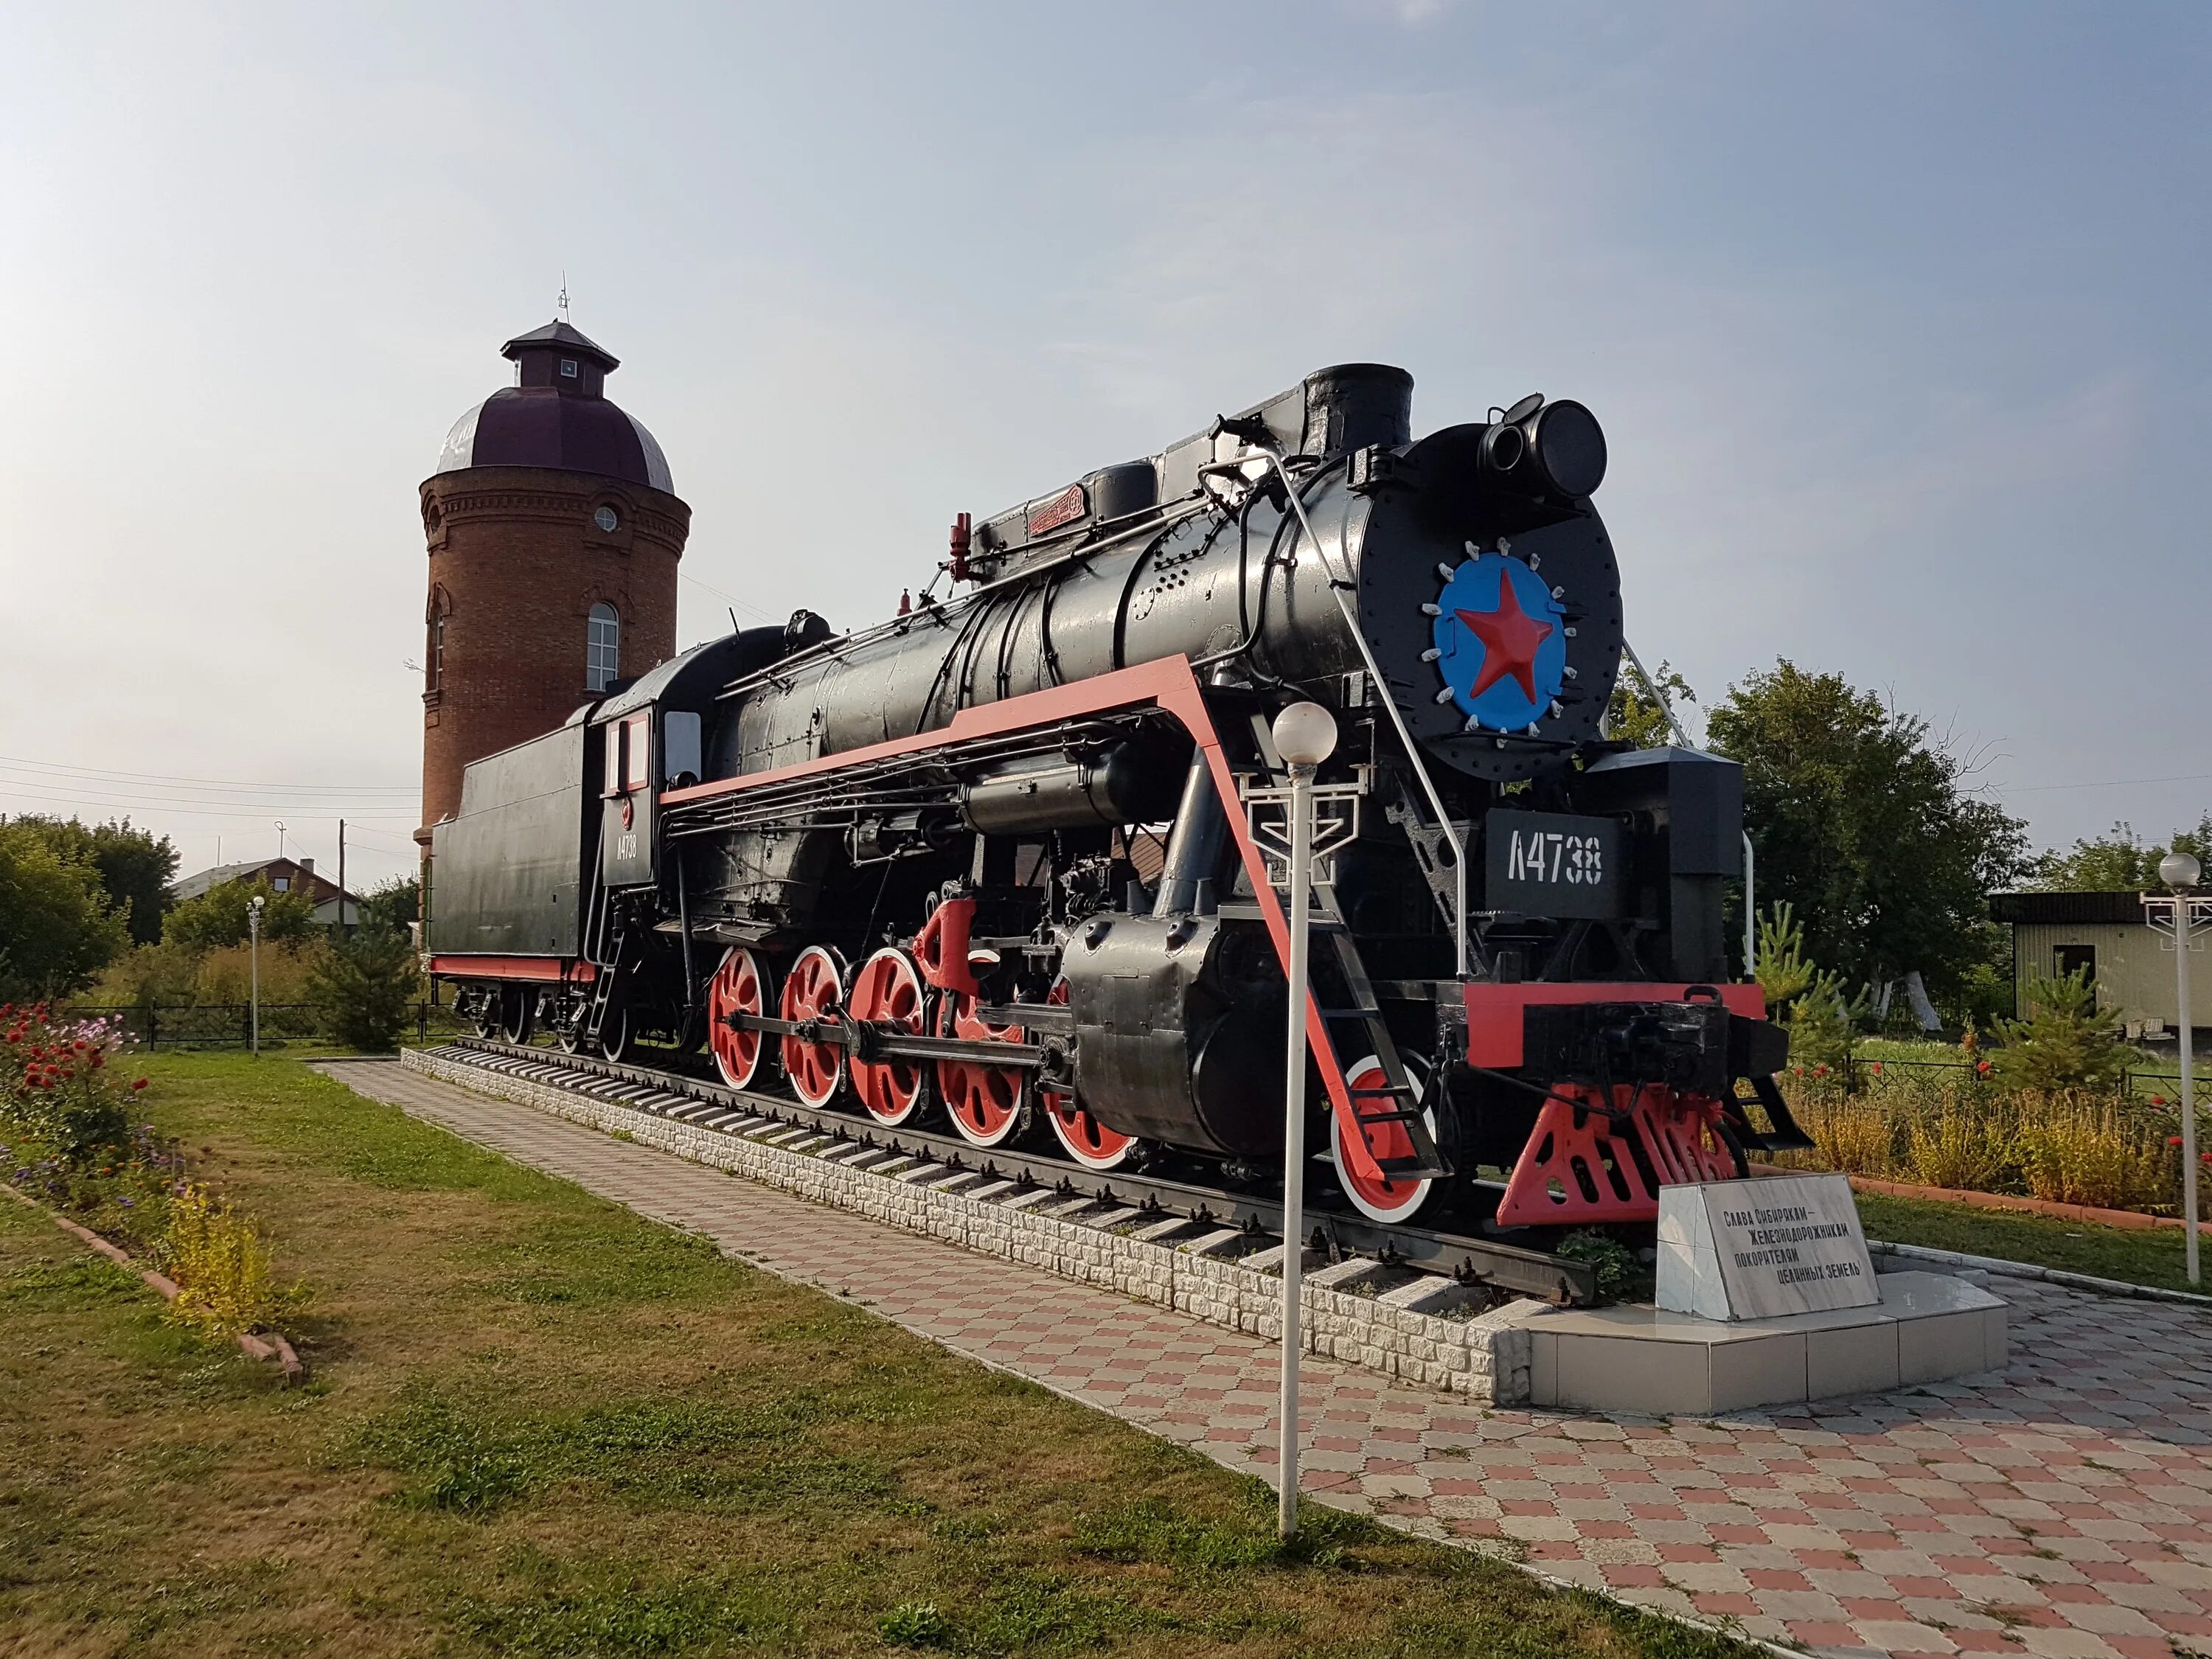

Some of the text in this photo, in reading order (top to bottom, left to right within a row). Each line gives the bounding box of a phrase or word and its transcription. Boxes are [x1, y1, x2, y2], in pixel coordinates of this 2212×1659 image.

[1724, 1211, 1754, 1227] СЛАВА
[1734, 1248, 1800, 1268] ПОКОРИТЕЛЯМ
[1777, 1265, 1825, 1286] ЦЕЛИННЫХ
